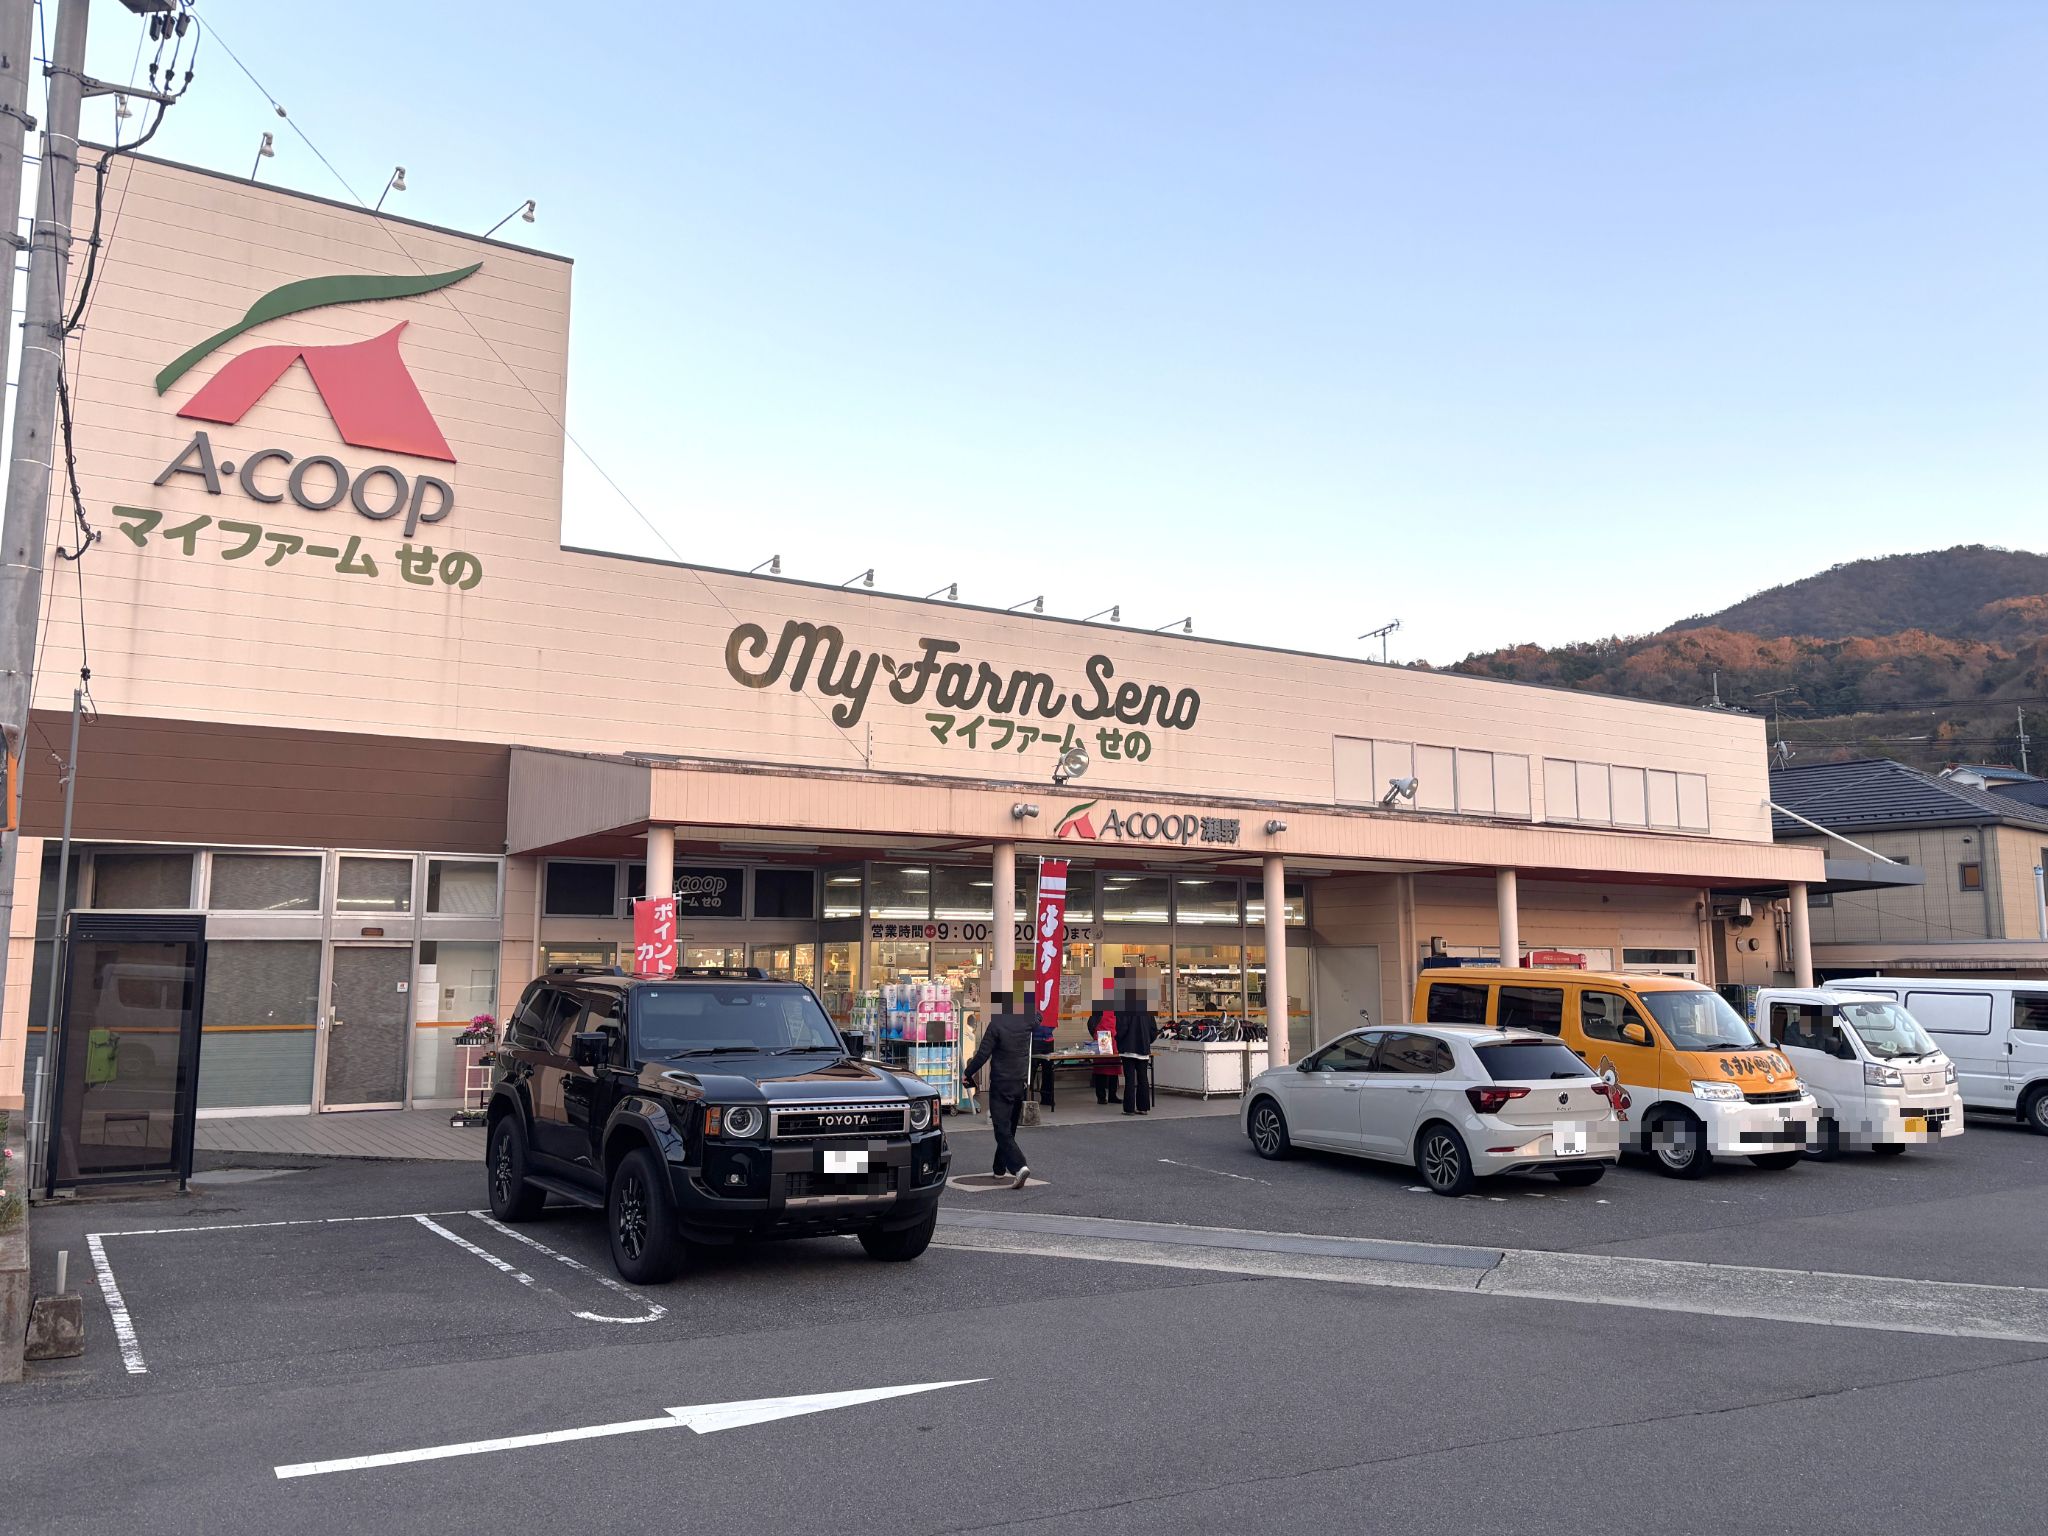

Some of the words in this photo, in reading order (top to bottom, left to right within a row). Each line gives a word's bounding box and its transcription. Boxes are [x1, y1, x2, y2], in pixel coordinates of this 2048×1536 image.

[111, 505, 378, 578] マイファーム
[395, 543, 483, 590] せの
[725, 619, 881, 729] My
[889, 637, 1066, 719] Farm
[1072, 655, 1201, 730] Seno
[925, 712, 1085, 754] マイファーム
[1096, 729, 1152, 762] せの
[654, 902, 674, 973] ポイント
[871, 923, 924, 939] 営業時間
[817, 1114, 869, 1126] TOYOTA
